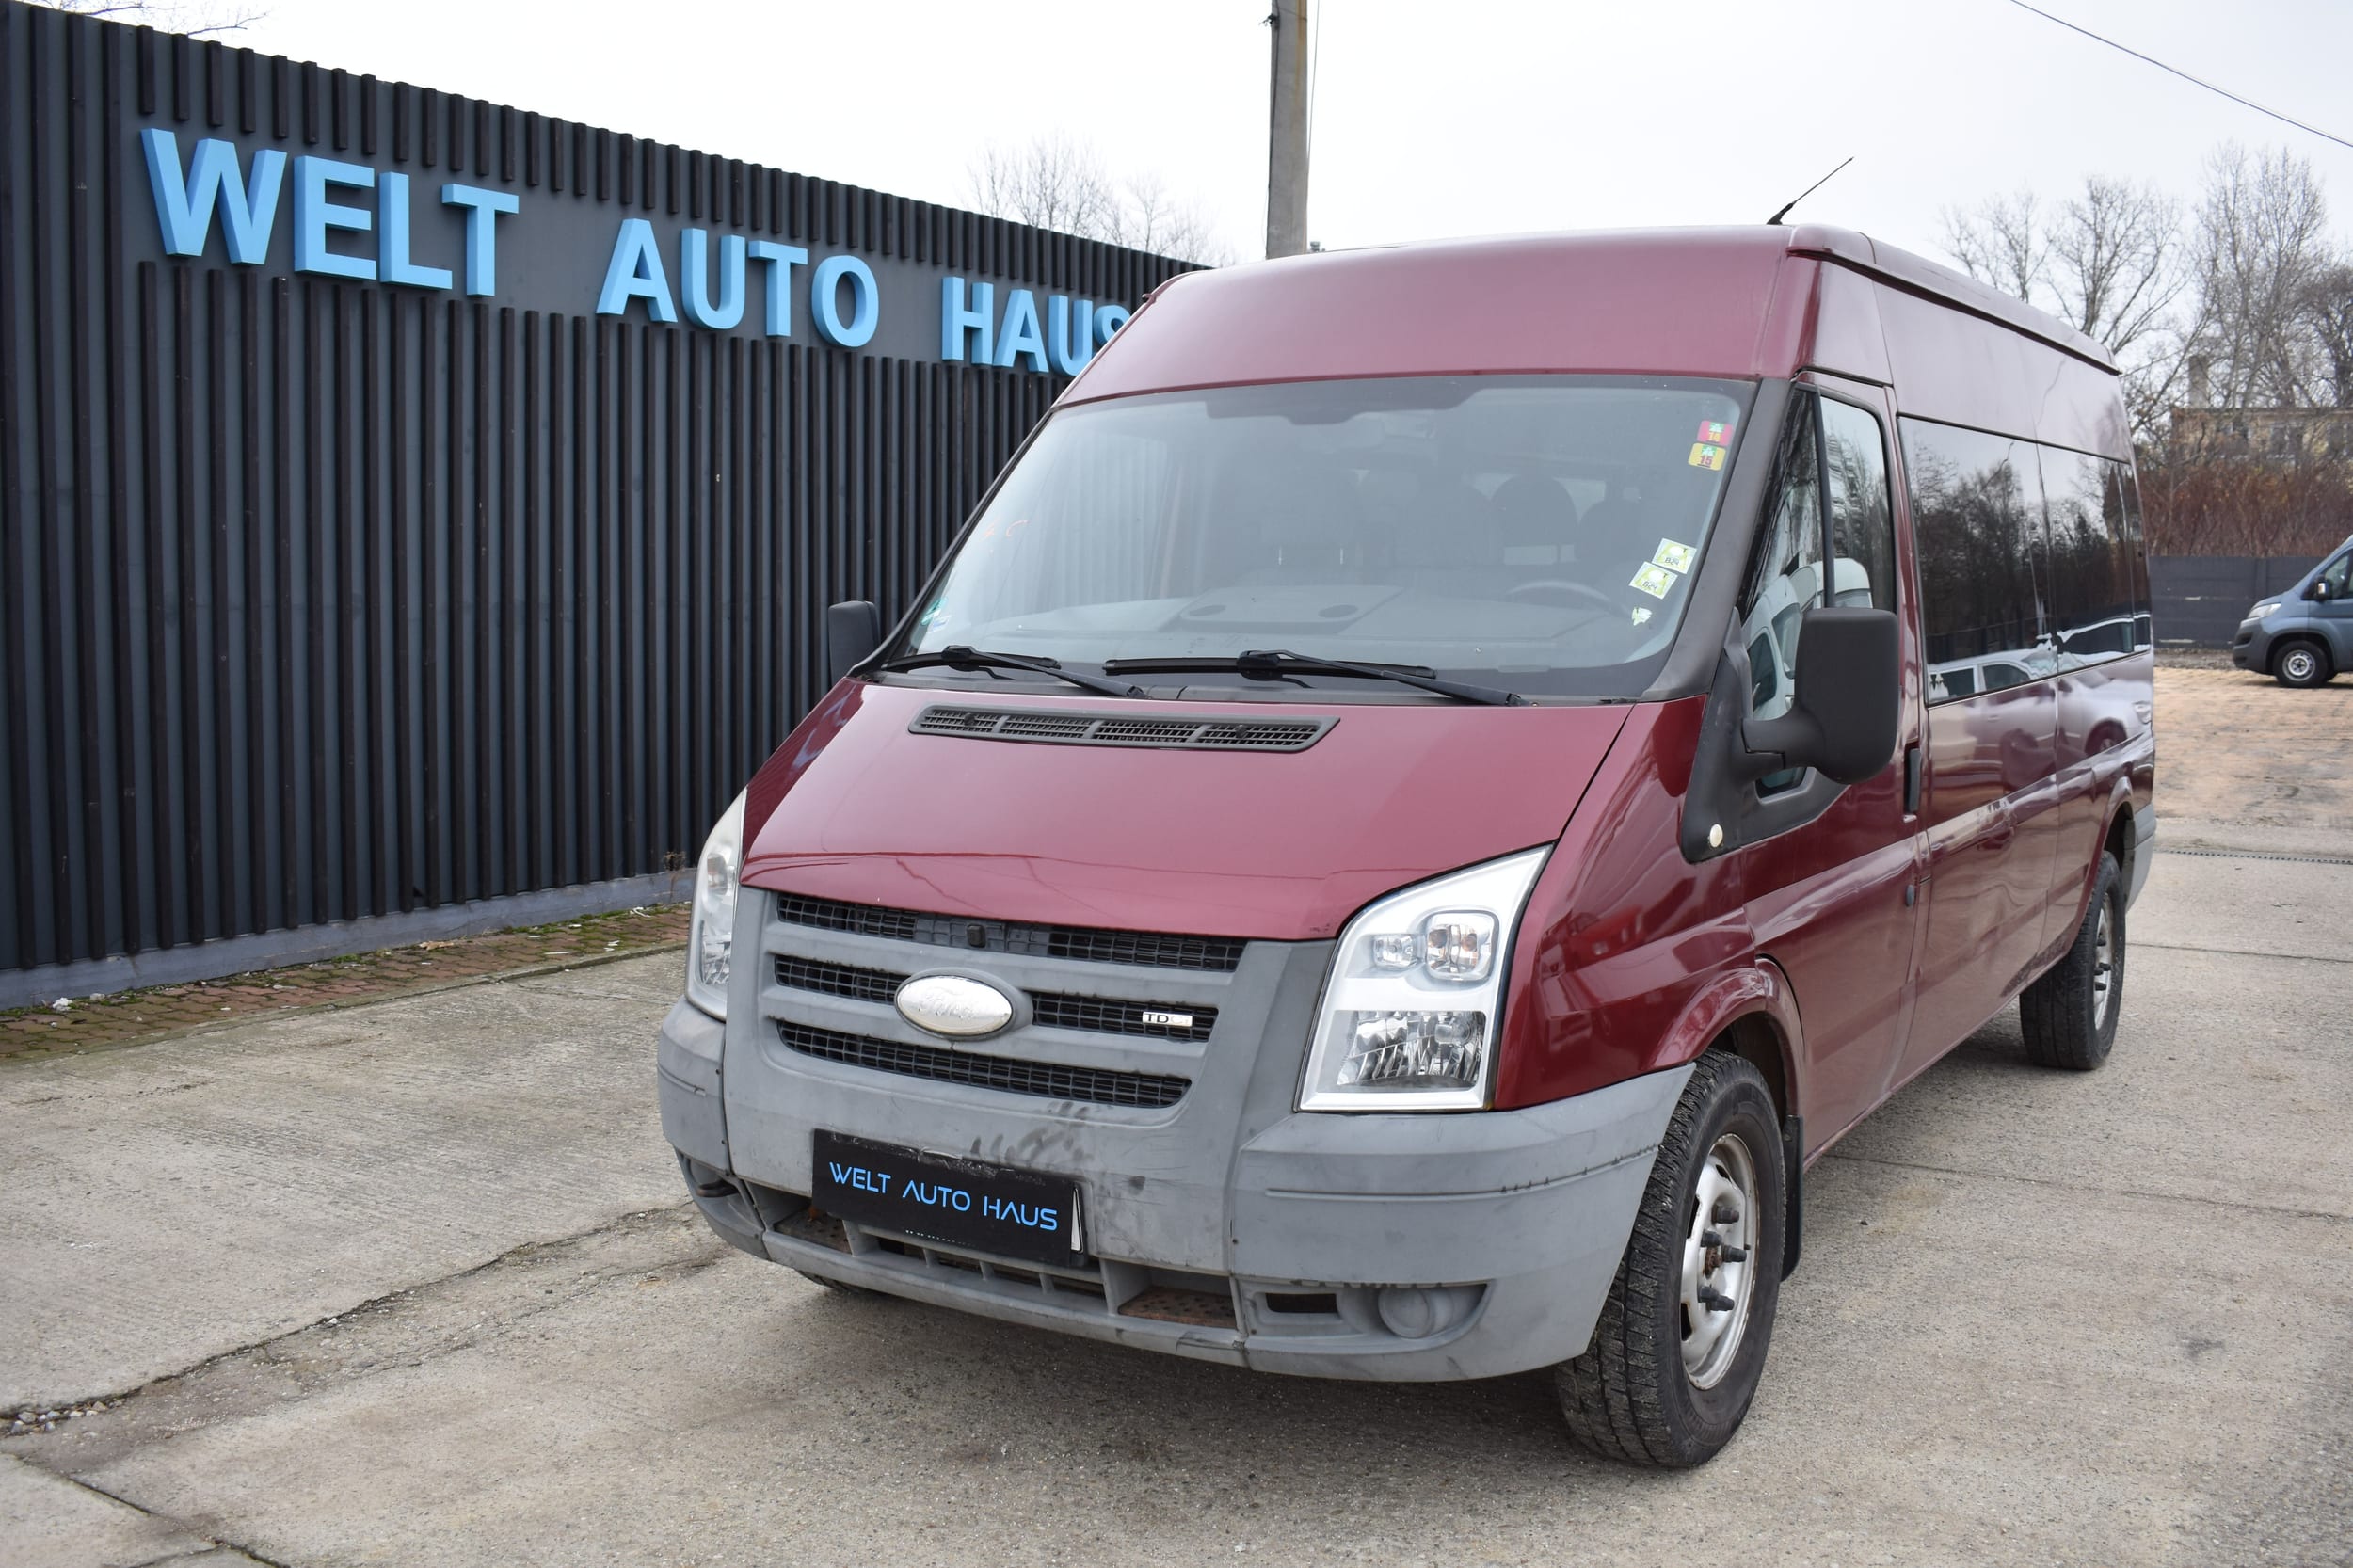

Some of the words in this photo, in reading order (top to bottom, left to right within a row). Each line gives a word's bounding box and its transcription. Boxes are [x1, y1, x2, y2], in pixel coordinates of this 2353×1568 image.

[139, 125, 521, 297] WELT
[594, 216, 881, 348] AUTO
[1700, 454, 1713, 466] 15
[829, 1161, 892, 1194] WELT
[902, 1179, 971, 1212] AUTO
[983, 1195, 1058, 1231] HAUS
